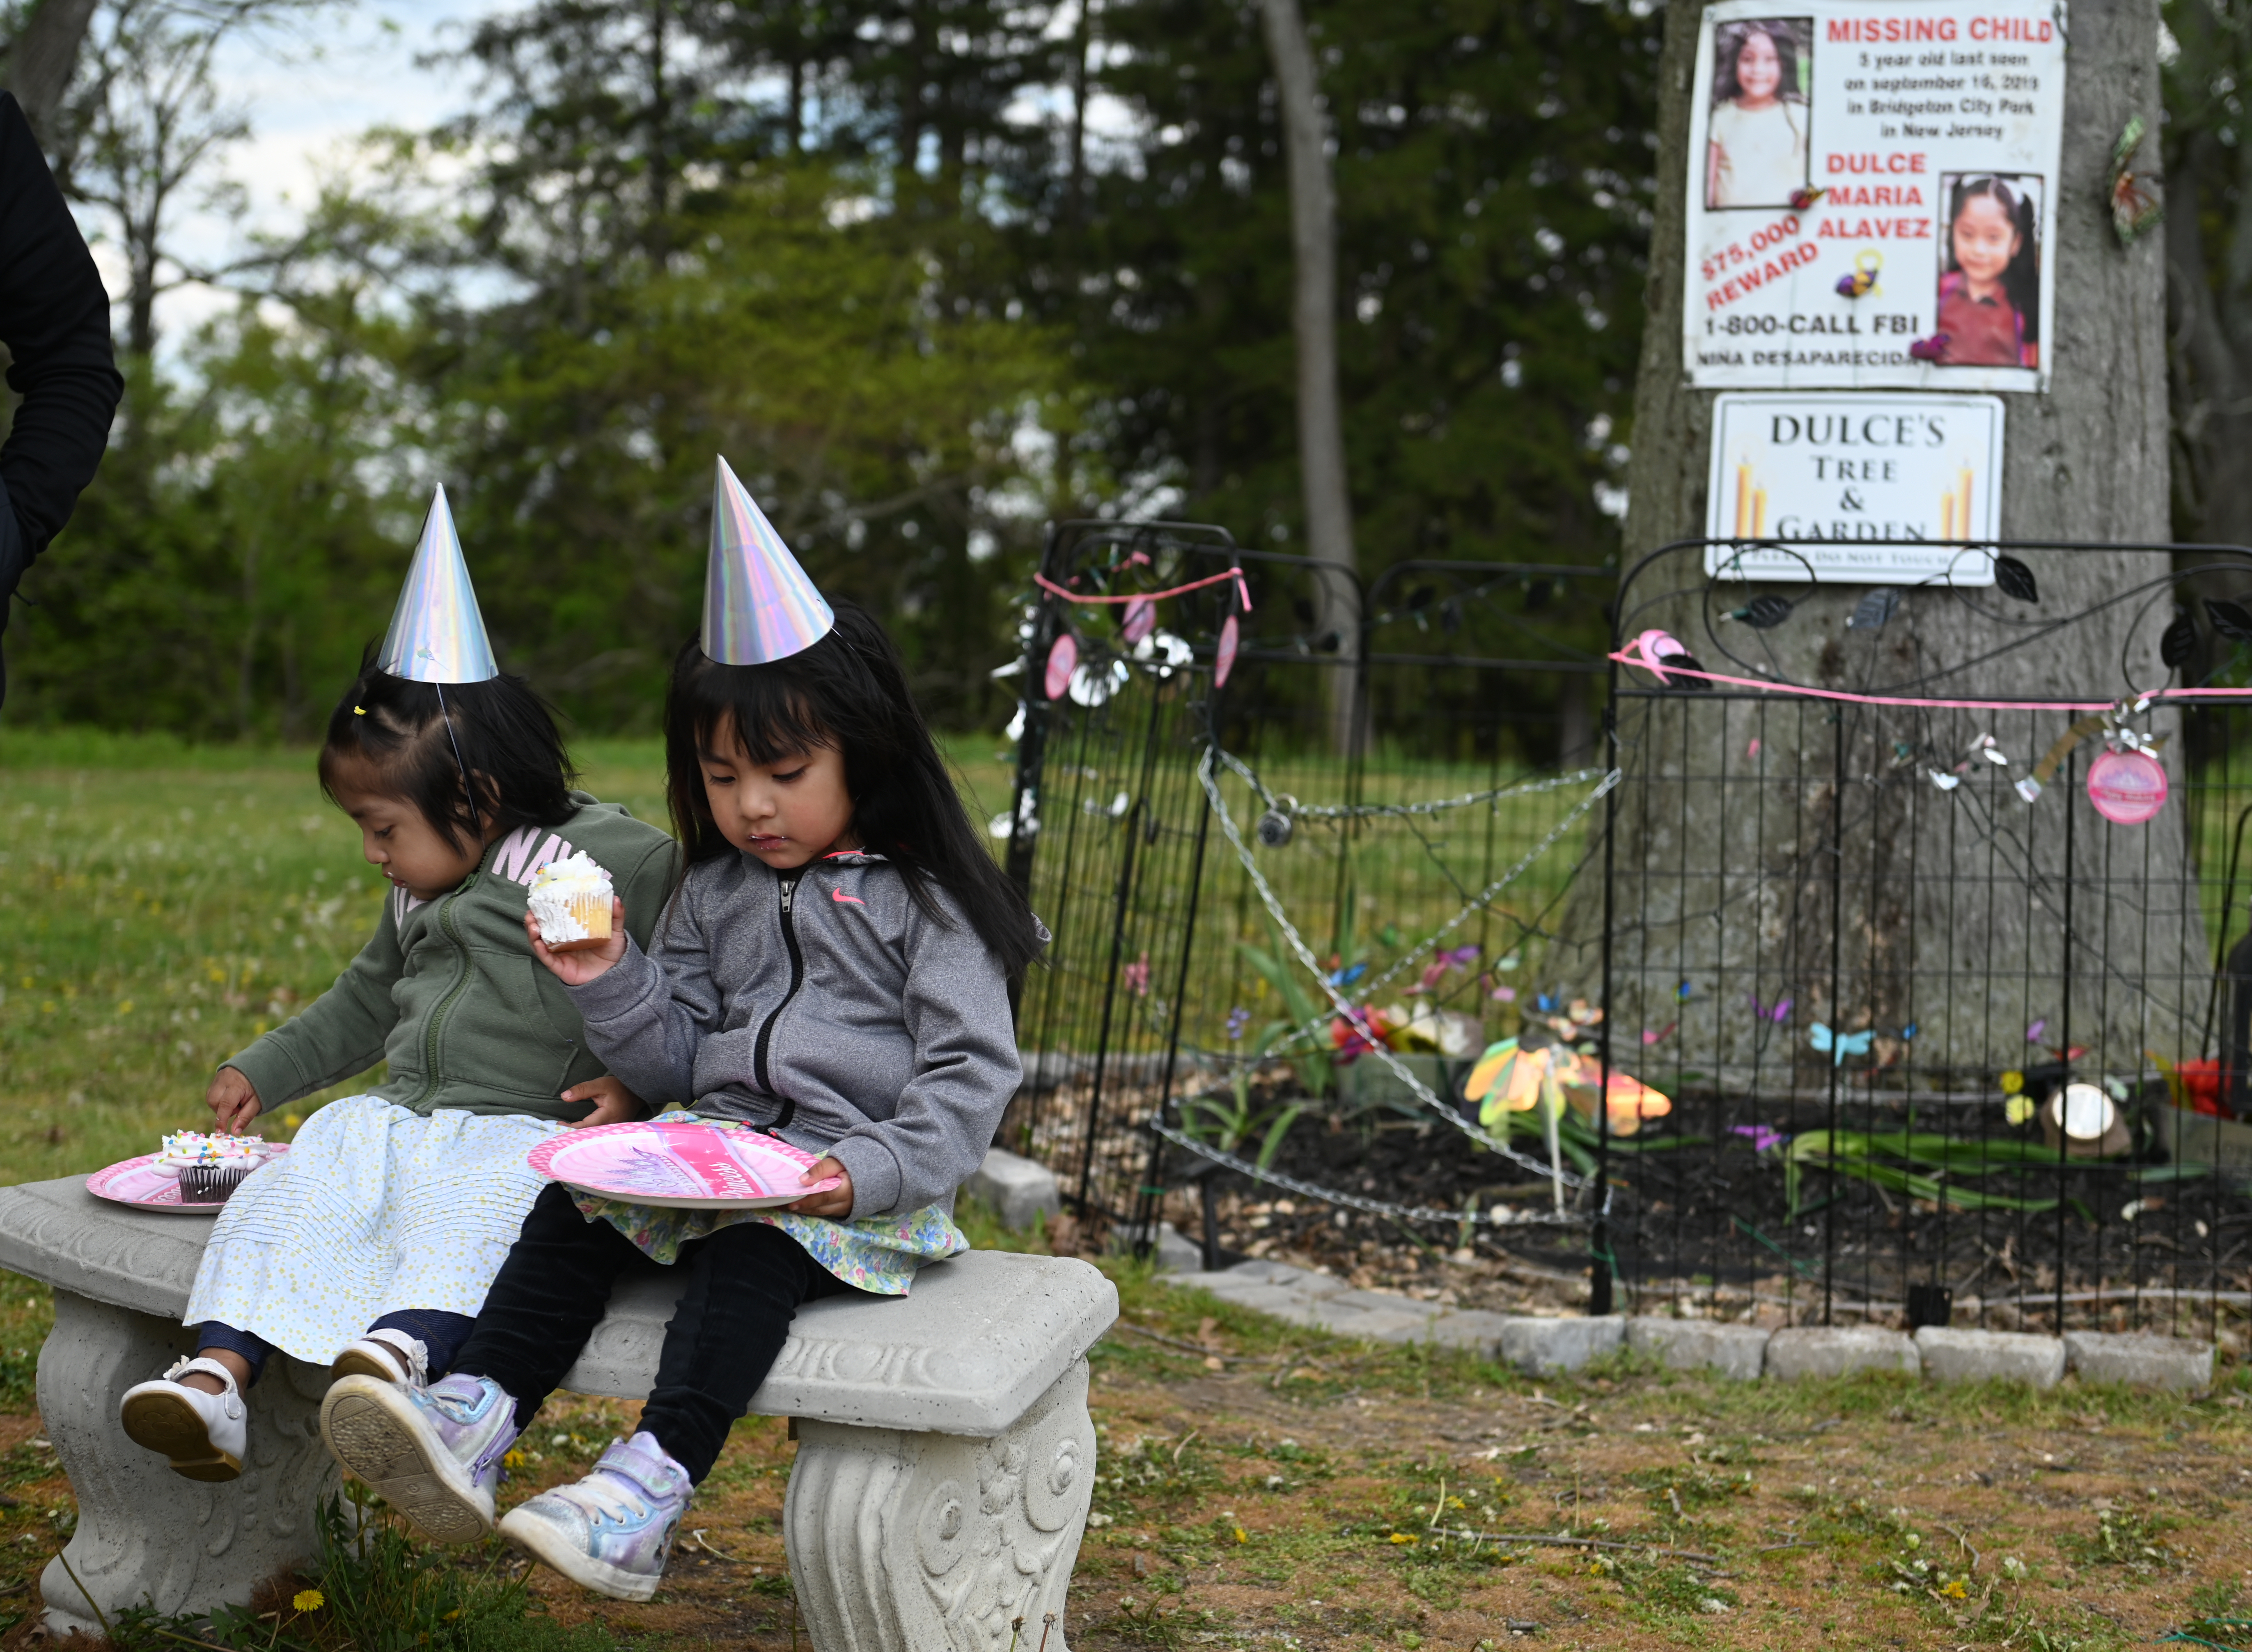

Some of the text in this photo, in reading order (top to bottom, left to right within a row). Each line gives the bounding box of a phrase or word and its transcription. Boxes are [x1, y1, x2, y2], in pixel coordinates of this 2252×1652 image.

[1828, 17, 2053, 43] MISSING CHILD
[1860, 51, 2028, 70] 5 year old last seen
[1844, 79, 1866, 91] on
[1872, 76, 1965, 94] september
[1847, 98, 2034, 117] in Bridgeton City Park
[1881, 124, 2003, 140] in New Jersey
[1827, 154, 1926, 174] DULCE
[1829, 186, 1923, 206] MARIA
[1818, 218, 1931, 239] ALAVEZ
[1701, 214, 1801, 281] $75,000
[1706, 242, 1819, 311] REWARD
[1706, 315, 1918, 335] 1-800-CALL FBI
[1770, 414, 1946, 447] DULCE'S
[1839, 488, 1866, 512] &
[1814, 551, 1842, 563] DO
[1847, 552, 1883, 563] NOT
